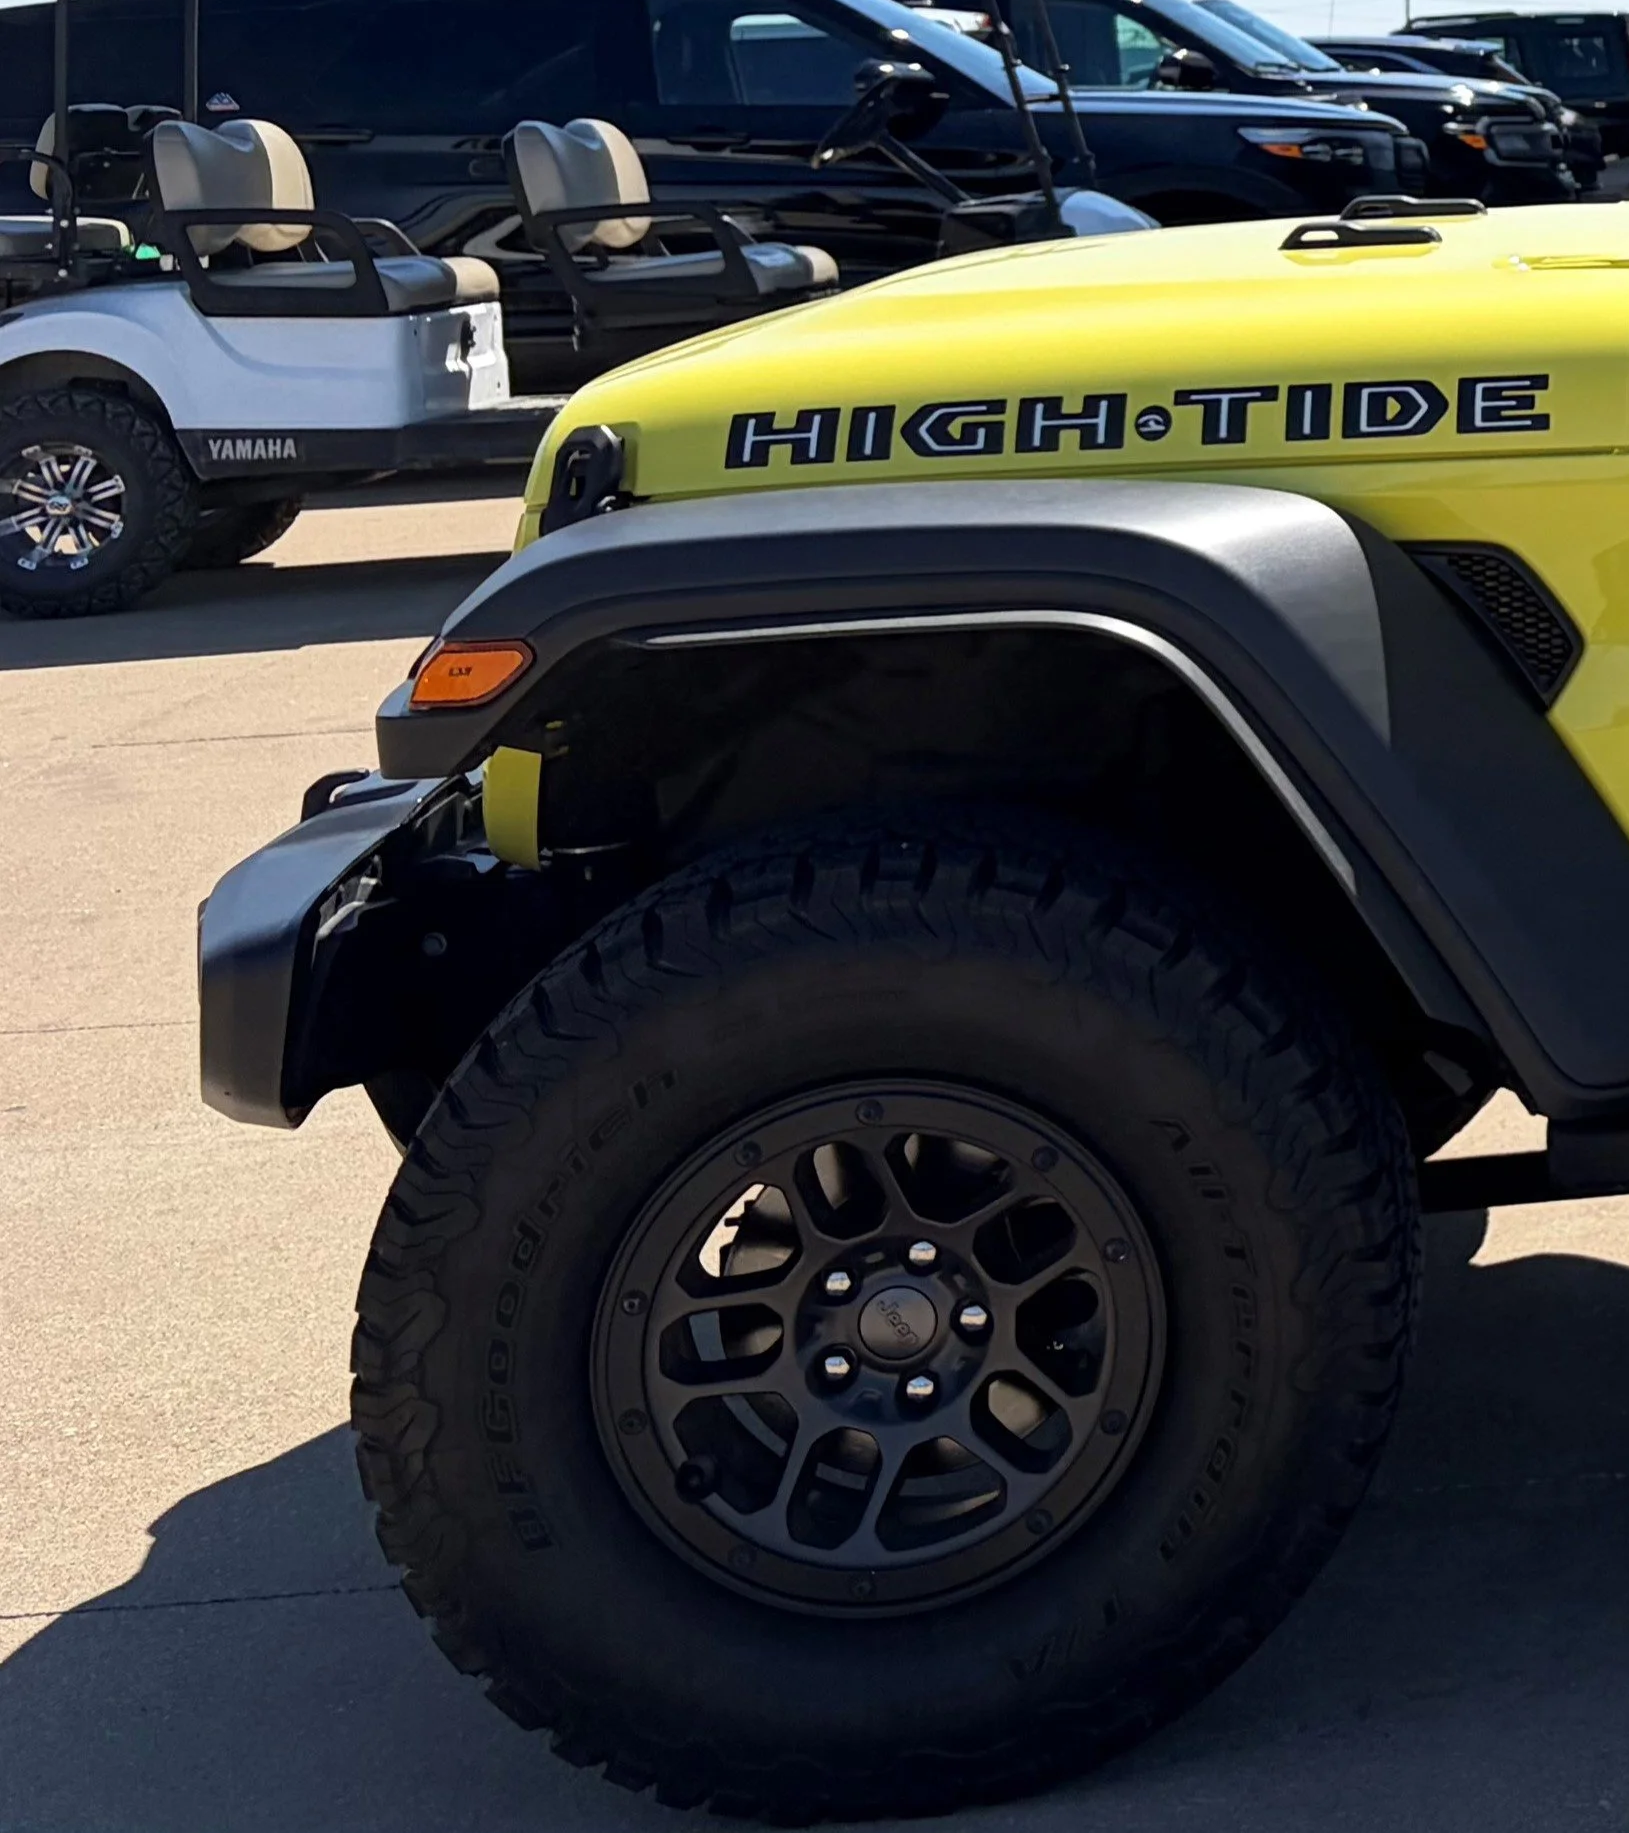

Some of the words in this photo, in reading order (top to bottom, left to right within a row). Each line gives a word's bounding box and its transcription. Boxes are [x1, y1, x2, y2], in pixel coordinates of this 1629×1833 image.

[724, 393, 1127, 469] HIGH
[1173, 373, 1552, 445] TIDE
[208, 438, 297, 461] YAMAHA
[874, 1299, 920, 1345] Jeep
